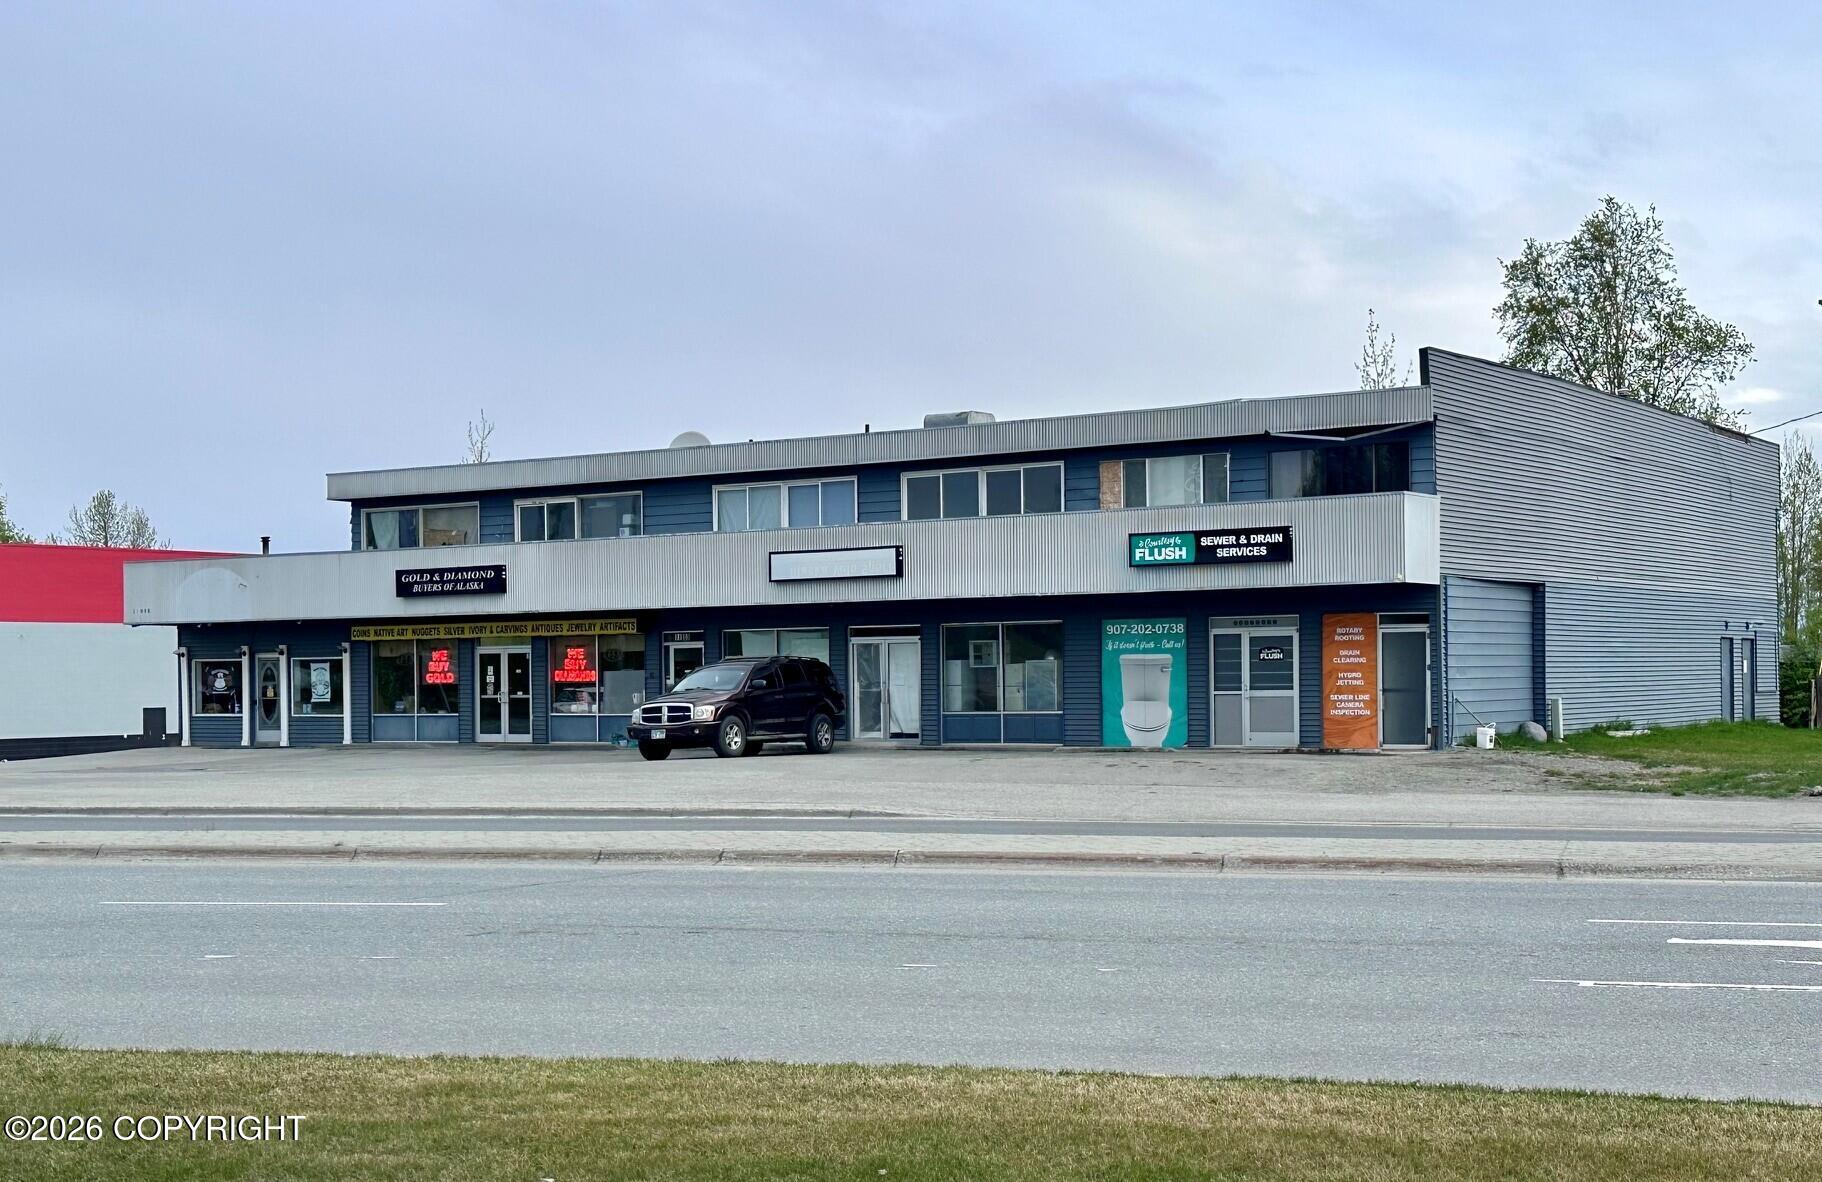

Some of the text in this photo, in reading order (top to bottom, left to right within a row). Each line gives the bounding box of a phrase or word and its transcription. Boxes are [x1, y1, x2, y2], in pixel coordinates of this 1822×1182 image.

[1200, 533, 1283, 546] SEWER & DRAIN
[1135, 547, 1187, 561] FLUSH
[1216, 546, 1267, 558] SERVICES
[401, 570, 495, 583] GOLD & DIAMOND
[412, 581, 484, 593] BUYERS OF ALASKA
[352, 628, 371, 638] COINS
[373, 627, 395, 638] NATIVE
[396, 627, 408, 637] ART
[411, 626, 440, 637] NUGGETS
[443, 625, 465, 636] SILVER
[468, 624, 487, 635] IVORY
[495, 623, 528, 634] CARVINGS
[531, 622, 564, 633] ANTIQUES
[566, 622, 597, 633] JEWELRY
[599, 620, 636, 632] ARTIFACTS
[1106, 623, 1185, 635] 907-202-0738
[432, 650, 449, 661] WE
[566, 648, 585, 659] WE
[428, 661, 450, 671] BUY
[425, 672, 455, 684] GOLD
